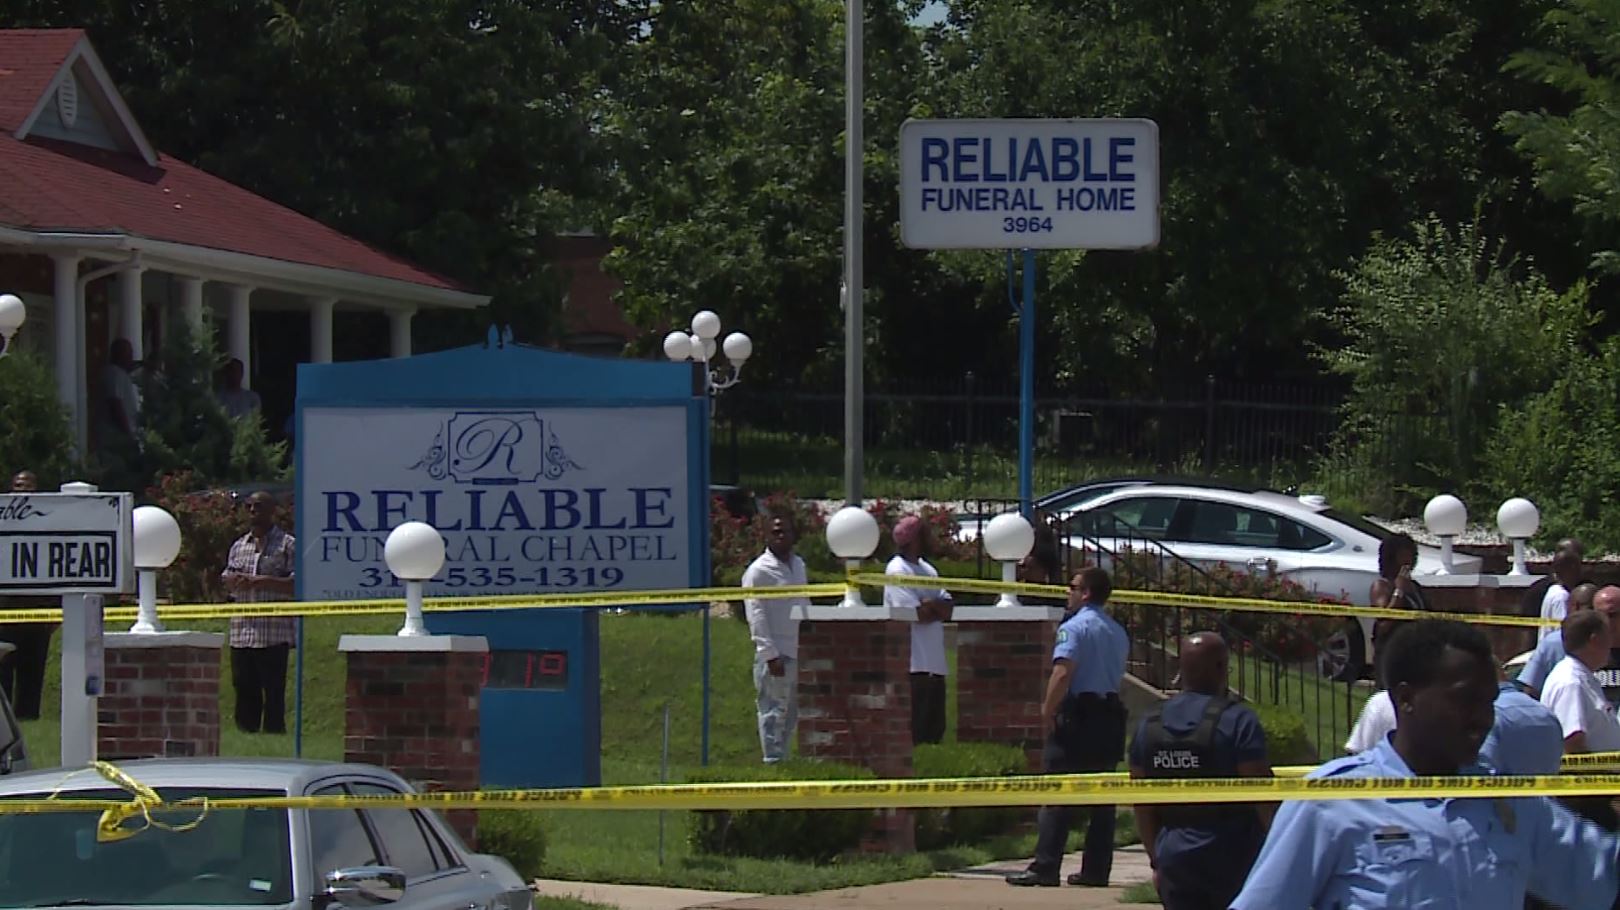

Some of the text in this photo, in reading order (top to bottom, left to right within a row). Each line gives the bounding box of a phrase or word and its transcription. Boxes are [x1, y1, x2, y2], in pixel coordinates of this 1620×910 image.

[921, 138, 1135, 182] RELIABLE
[921, 187, 1135, 212] FUNERAL HOME
[1003, 217, 1053, 232] 3964
[321, 488, 675, 532] RELIABLE
[12, 542, 111, 578] IN REAR
[320, 535, 677, 562] FUAL CHAPEL
[359, 567, 624, 588] 31-535-1319
[1153, 756, 1200, 768] POLICE
